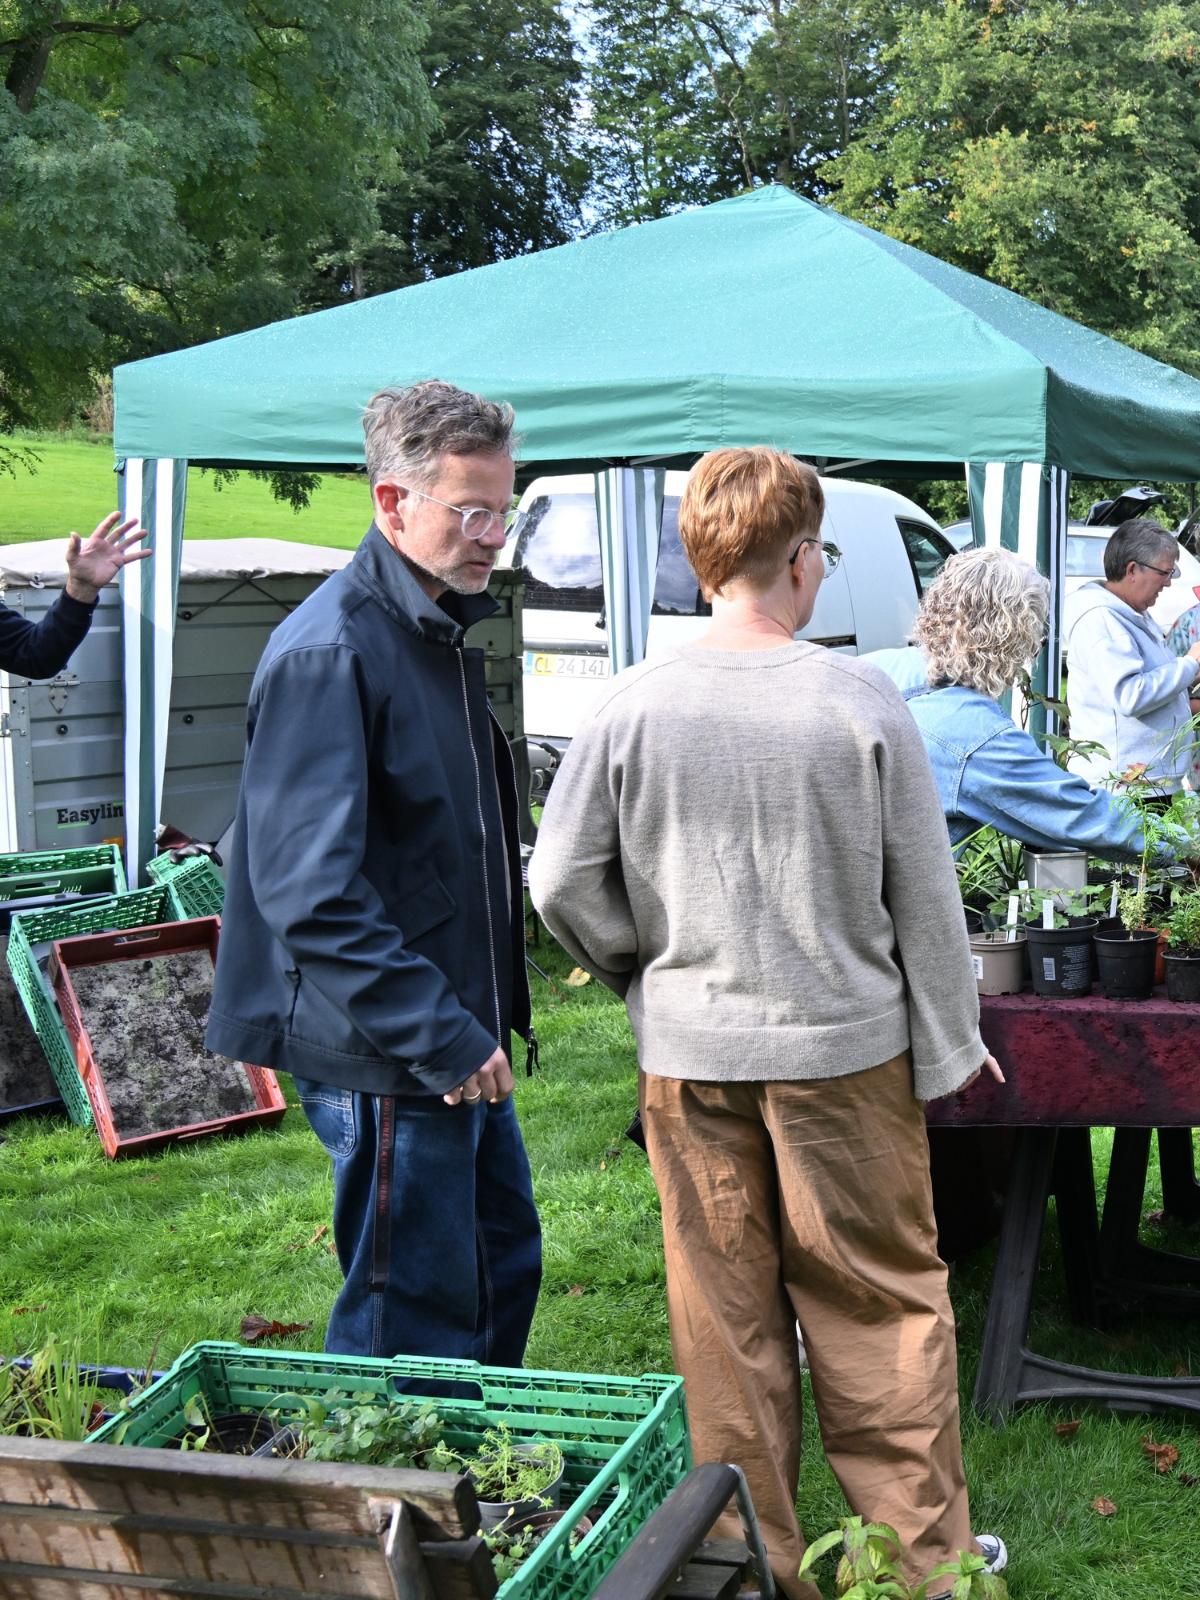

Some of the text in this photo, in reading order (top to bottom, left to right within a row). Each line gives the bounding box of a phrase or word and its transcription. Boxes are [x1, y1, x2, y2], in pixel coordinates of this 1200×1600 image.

[535, 657, 605, 676] CL 24 141
